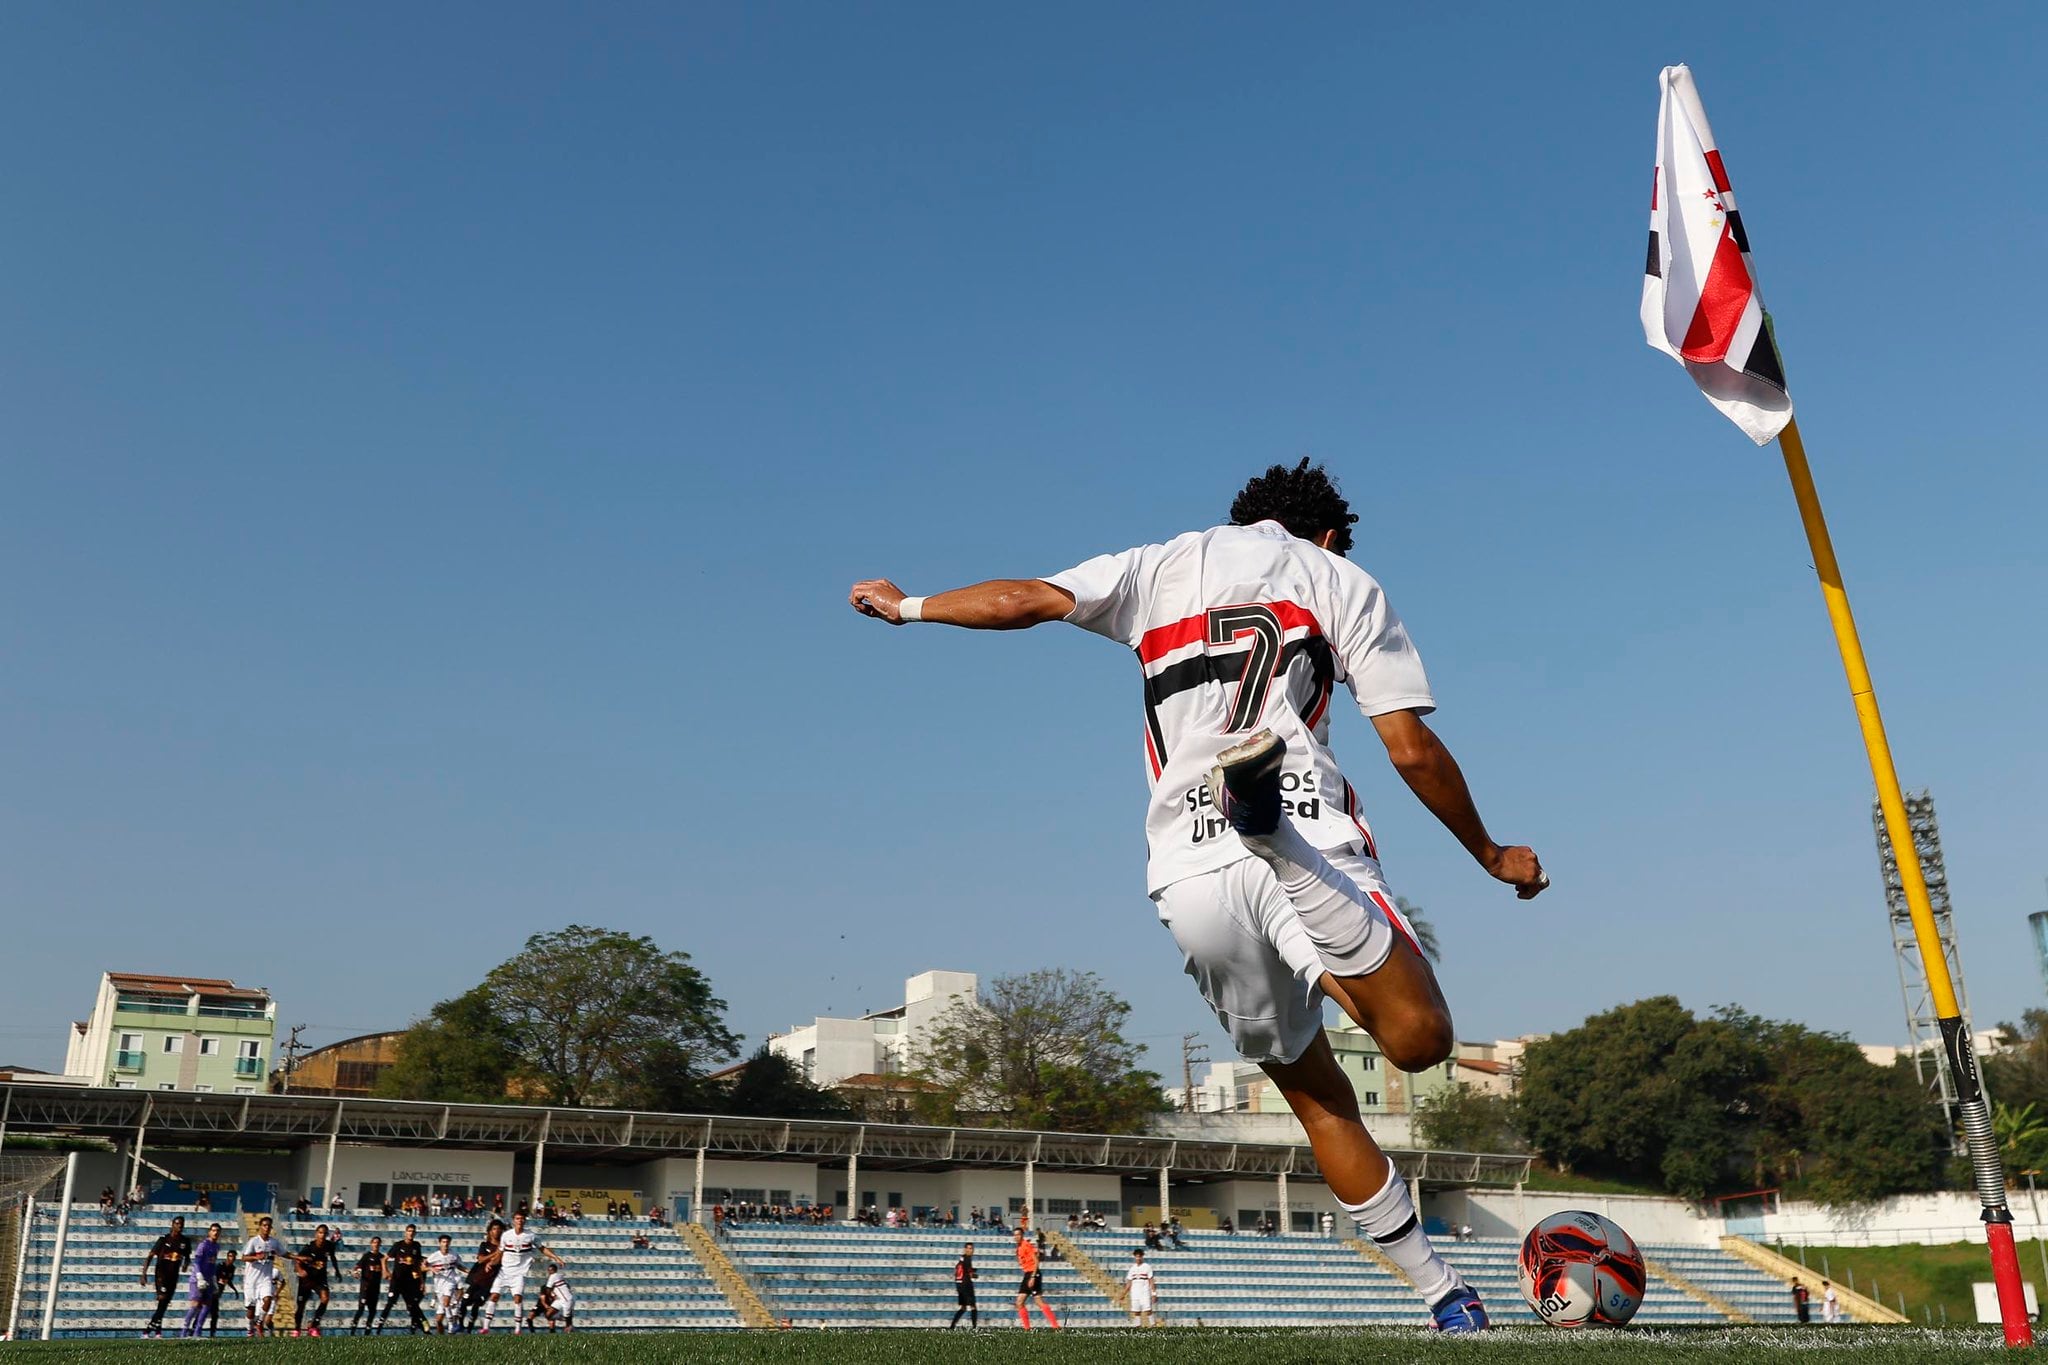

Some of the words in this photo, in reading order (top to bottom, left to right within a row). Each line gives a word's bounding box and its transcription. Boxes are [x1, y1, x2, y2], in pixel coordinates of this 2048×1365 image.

[1206, 603, 1284, 735] 7
[1186, 770, 1316, 812] SEOS
[1192, 798, 1320, 843] Uned
[391, 1171, 471, 1182] LANCHONETE
[579, 1189, 610, 1199] SAÍDA
[1264, 1200, 1316, 1209] LANONETE
[1539, 1293, 1572, 1317] Top
